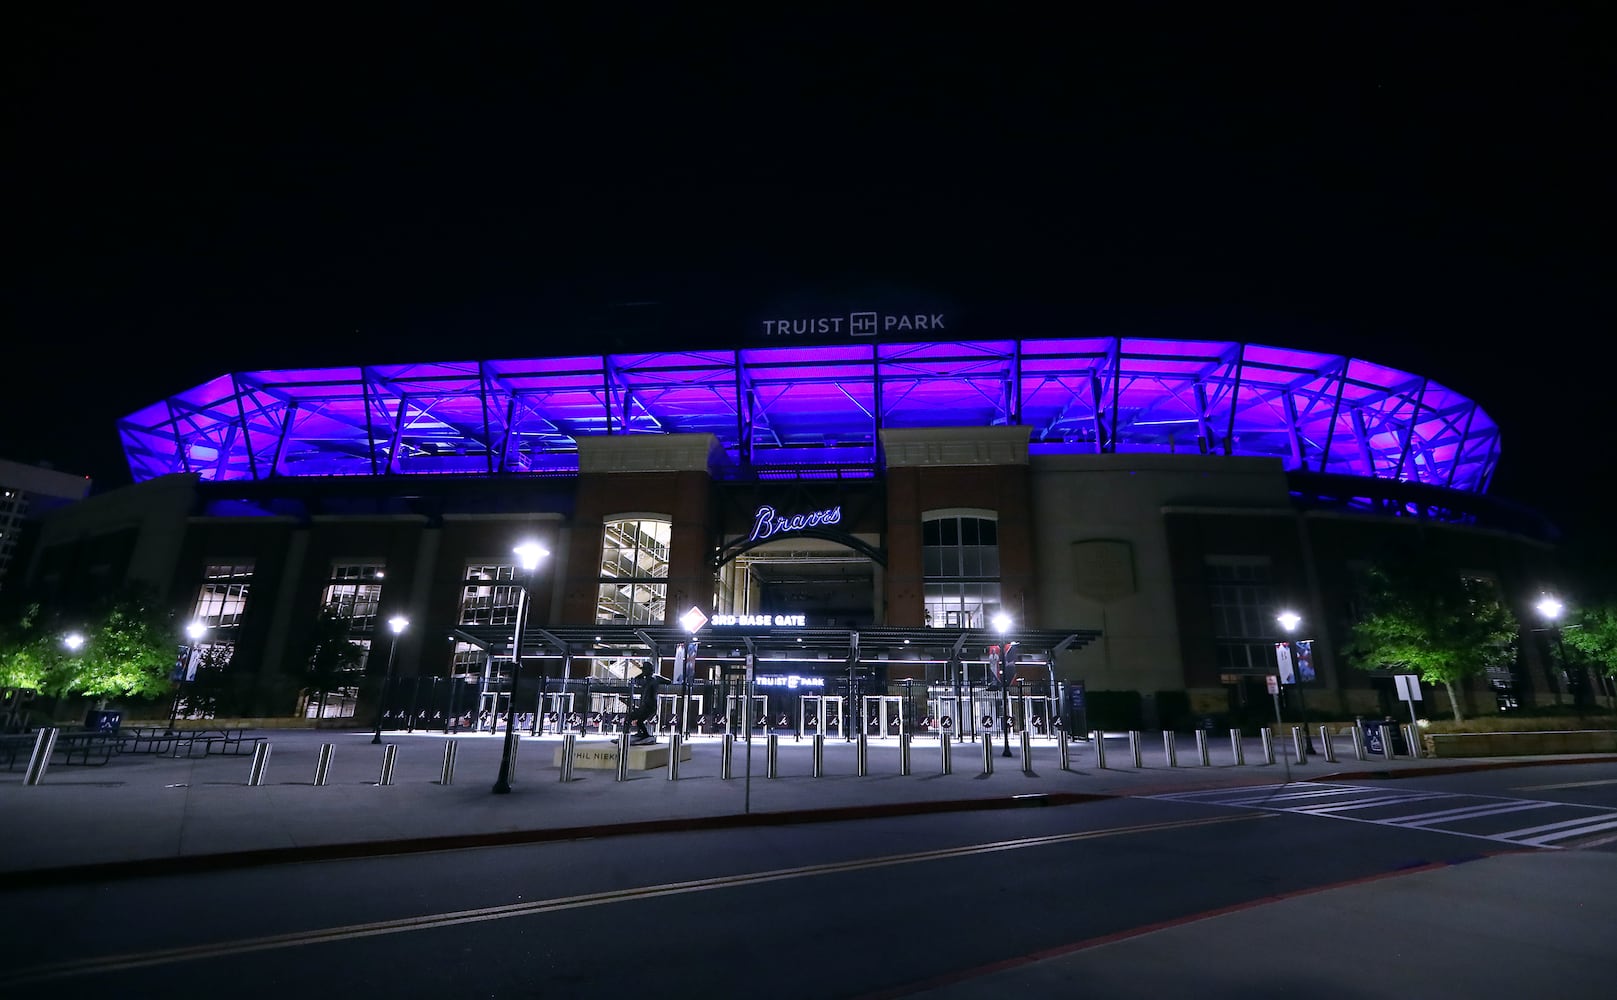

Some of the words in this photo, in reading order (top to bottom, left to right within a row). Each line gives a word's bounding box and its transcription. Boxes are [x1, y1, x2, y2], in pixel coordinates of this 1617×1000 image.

[762, 317, 845, 335] TRUIST
[884, 313, 945, 331] PARK
[749, 504, 842, 541] Braves
[711, 614, 737, 626] 3RD
[738, 614, 772, 626] BASE
[774, 614, 806, 626] GATE
[755, 676, 788, 686] TRUIST
[799, 676, 825, 687] PARK
[573, 752, 591, 760] HIL
